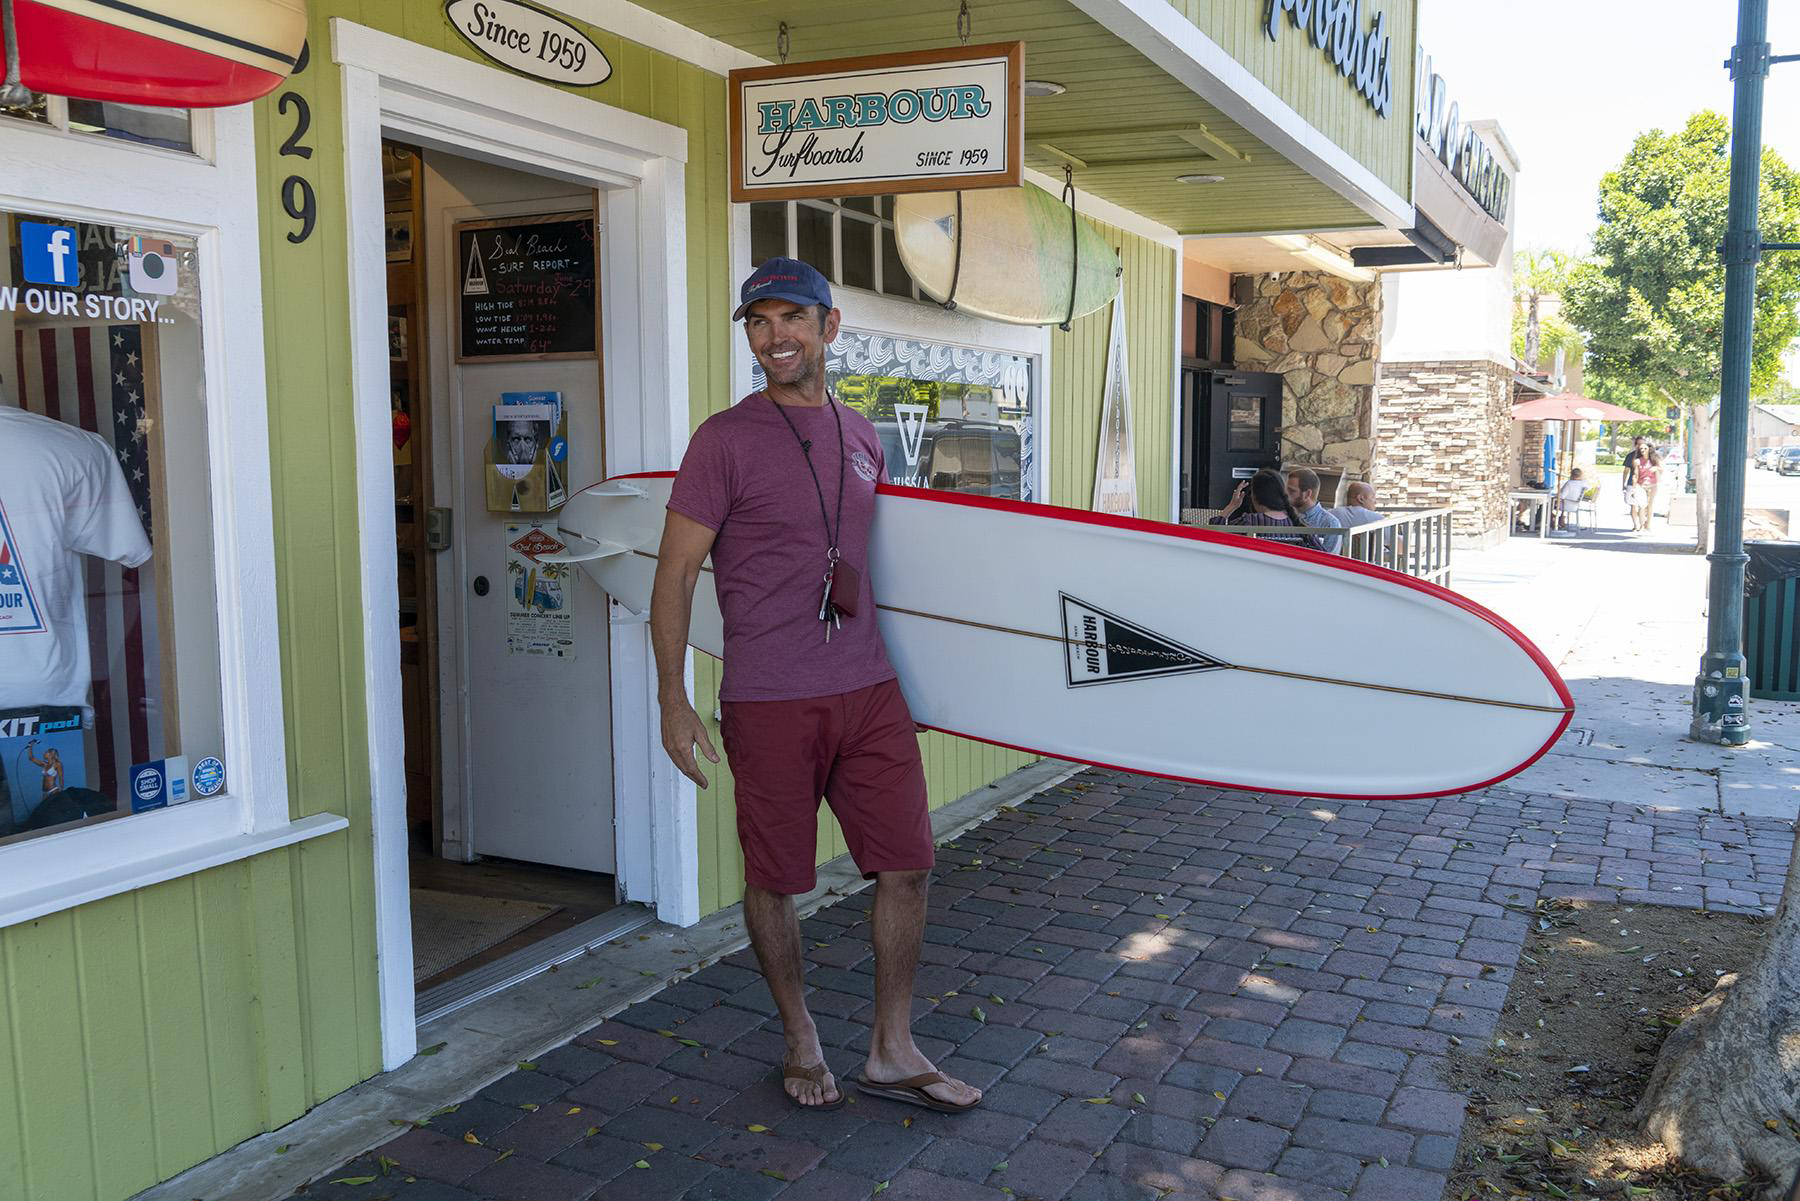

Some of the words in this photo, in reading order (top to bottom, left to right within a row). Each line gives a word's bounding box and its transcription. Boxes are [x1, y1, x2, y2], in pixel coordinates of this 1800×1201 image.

[467, 2, 531, 53] Since
[536, 30, 587, 72] 1959
[757, 84, 991, 135] HARBOUR
[752, 124, 865, 177] Surfboards
[916, 151, 951, 167] SINCE
[959, 149, 989, 166] 1959
[25, 289, 80, 316] OUR
[85, 294, 175, 324] STORY...
[475, 302, 495, 311] HIGH
[497, 301, 513, 310] TIDE
[501, 325, 526, 333] HEIGHT
[1083, 615, 1100, 674] HARBOUR
